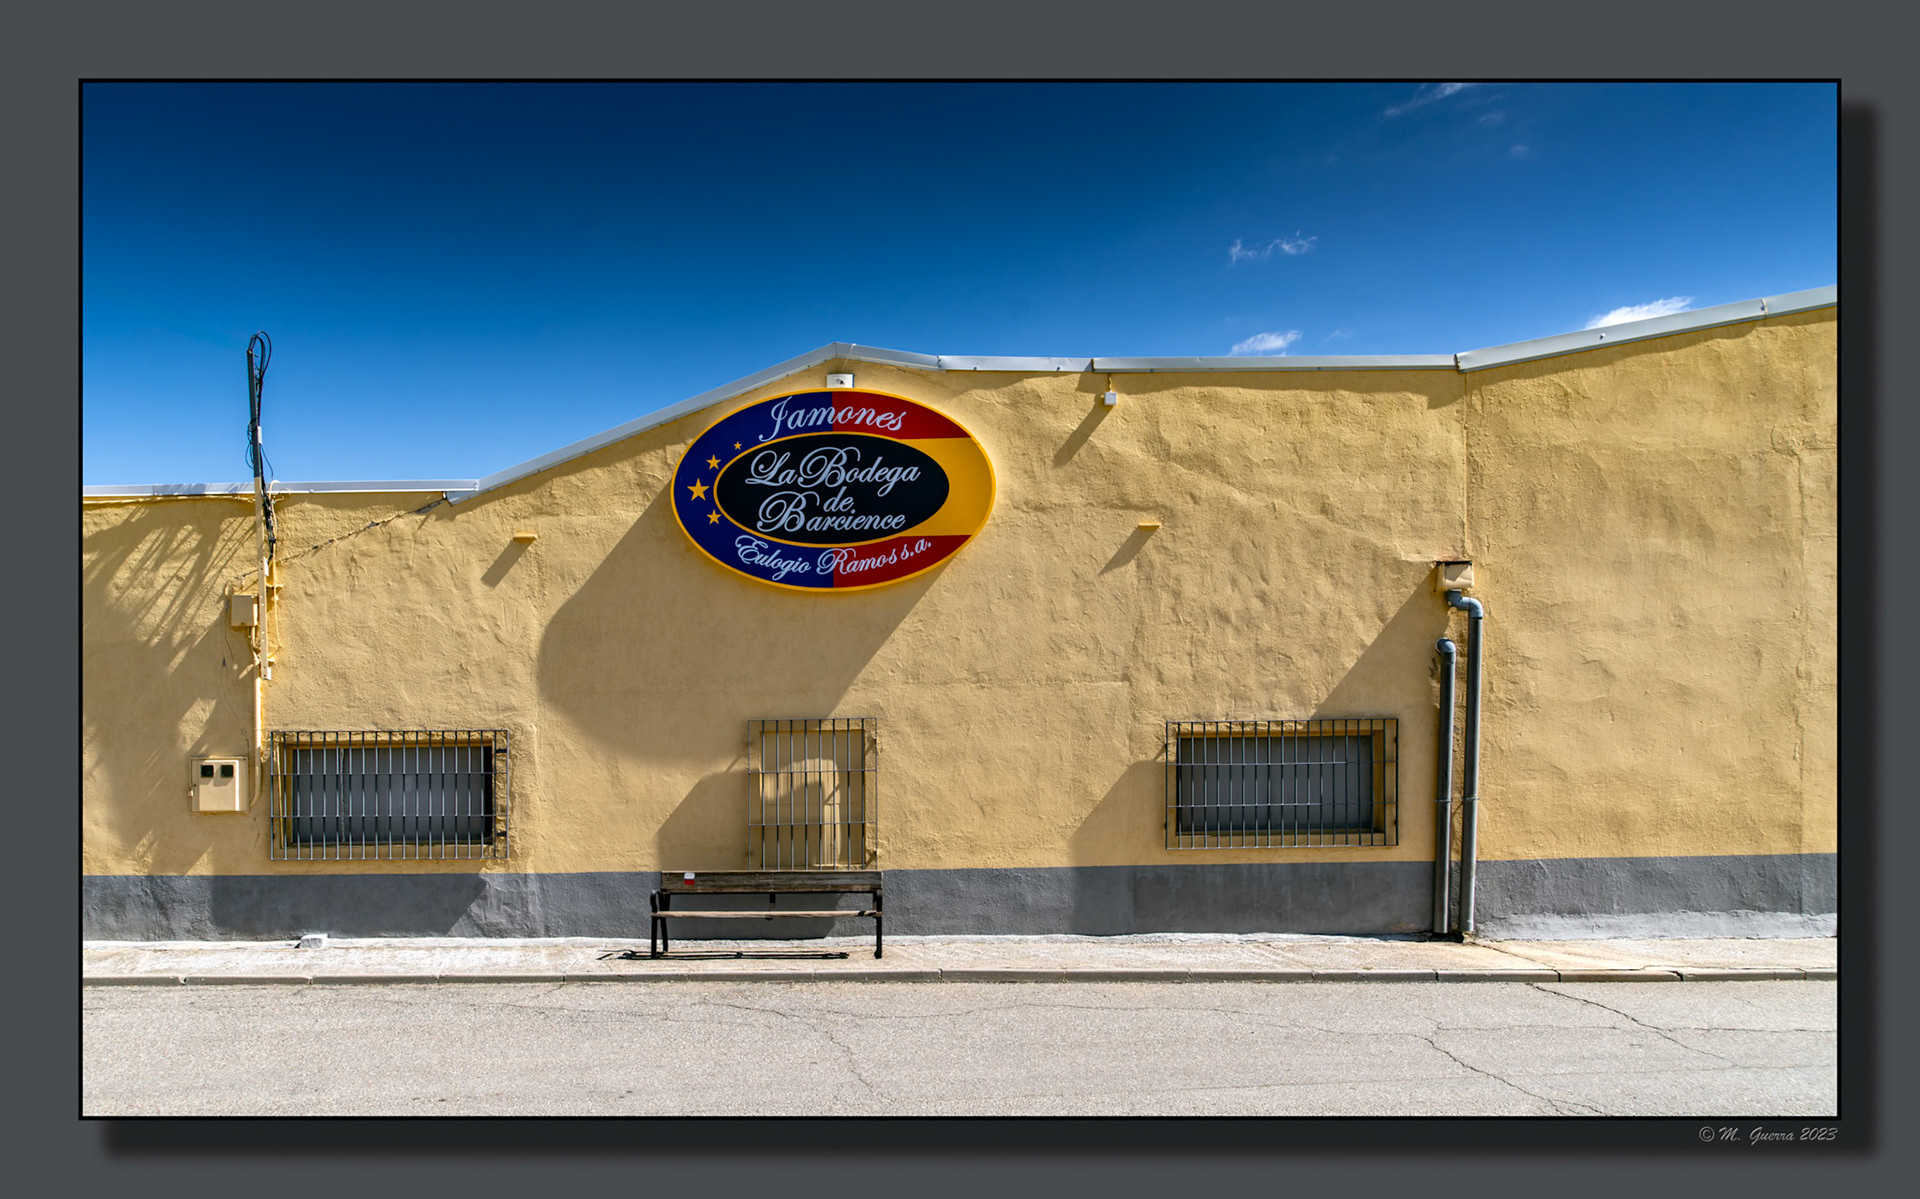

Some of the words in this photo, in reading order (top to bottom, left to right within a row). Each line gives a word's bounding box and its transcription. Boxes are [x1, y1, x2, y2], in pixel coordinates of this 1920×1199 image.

[758, 395, 907, 442] Jamones
[745, 450, 798, 487] La
[797, 446, 921, 497] Bodega
[756, 491, 906, 532] Barcience
[823, 486, 854, 513] de
[735, 534, 812, 581] Eulogio
[816, 547, 897, 575] Ramos
[900, 538, 932, 560] s.a.
